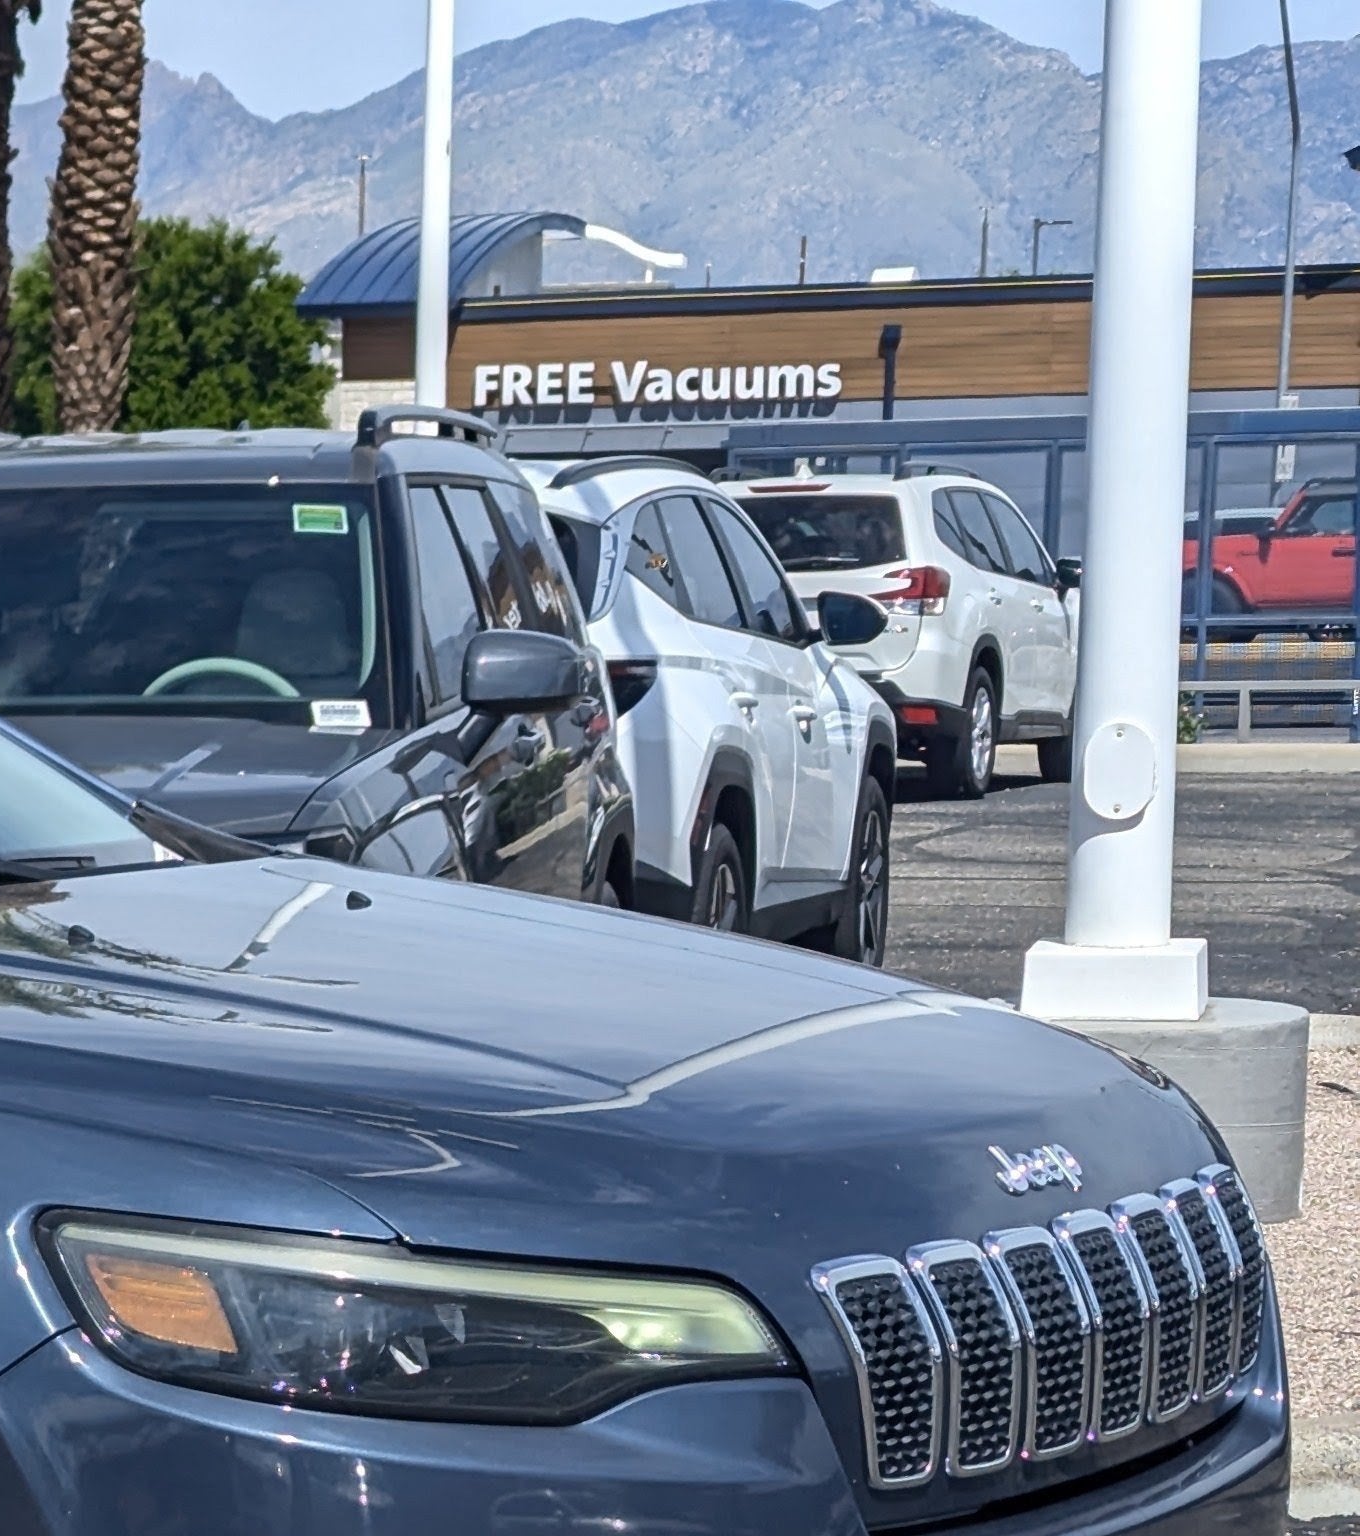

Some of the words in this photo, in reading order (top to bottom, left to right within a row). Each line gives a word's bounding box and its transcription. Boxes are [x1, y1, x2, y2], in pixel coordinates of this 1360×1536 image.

[473, 362, 595, 405] FREE
[611, 360, 842, 404] Vacuums
[987, 1143, 1082, 1192] Jeep
